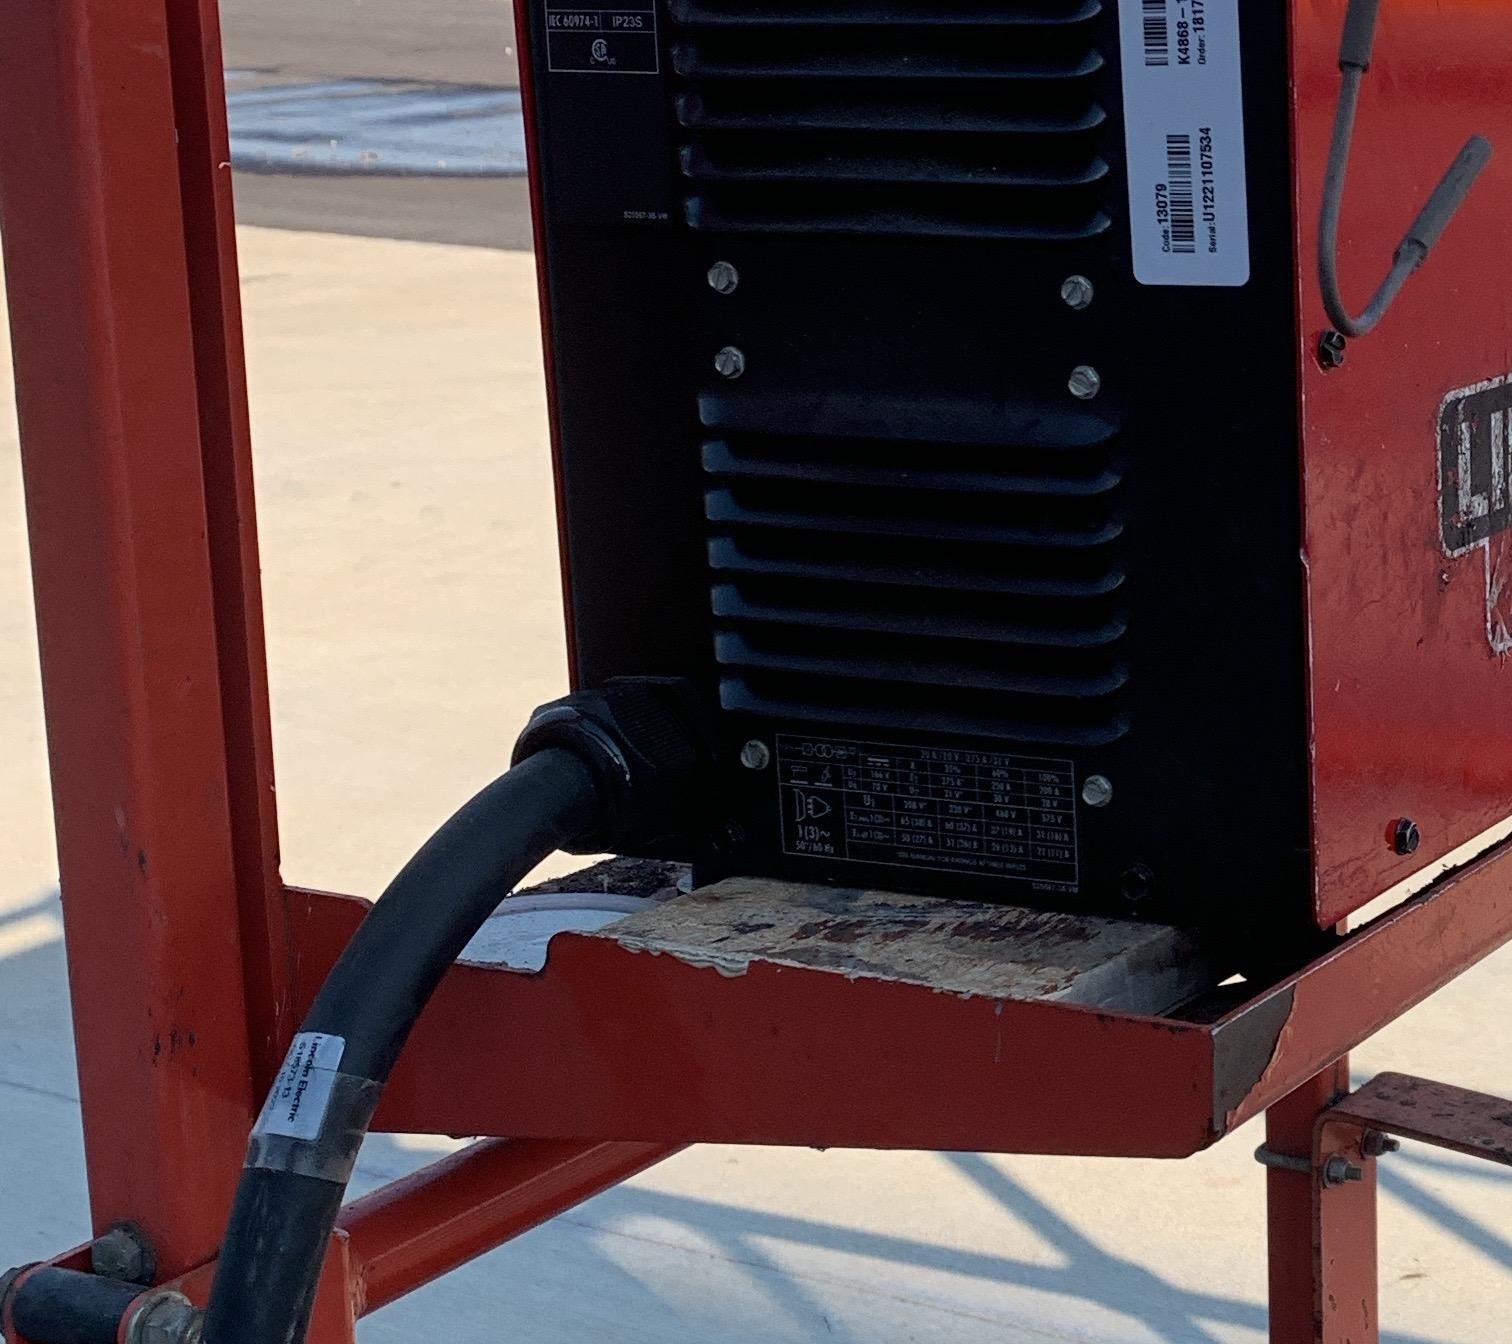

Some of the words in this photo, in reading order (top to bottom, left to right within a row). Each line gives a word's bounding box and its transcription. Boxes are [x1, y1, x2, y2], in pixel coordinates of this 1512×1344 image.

[548, 14, 562, 27] IEC
[562, 15, 599, 28] 60974-1
[612, 15, 643, 28] IP23S
[1198, 127, 1216, 222] U1221107534
[1155, 183, 1169, 225] 13079
[287, 1079, 309, 1123] Electric
